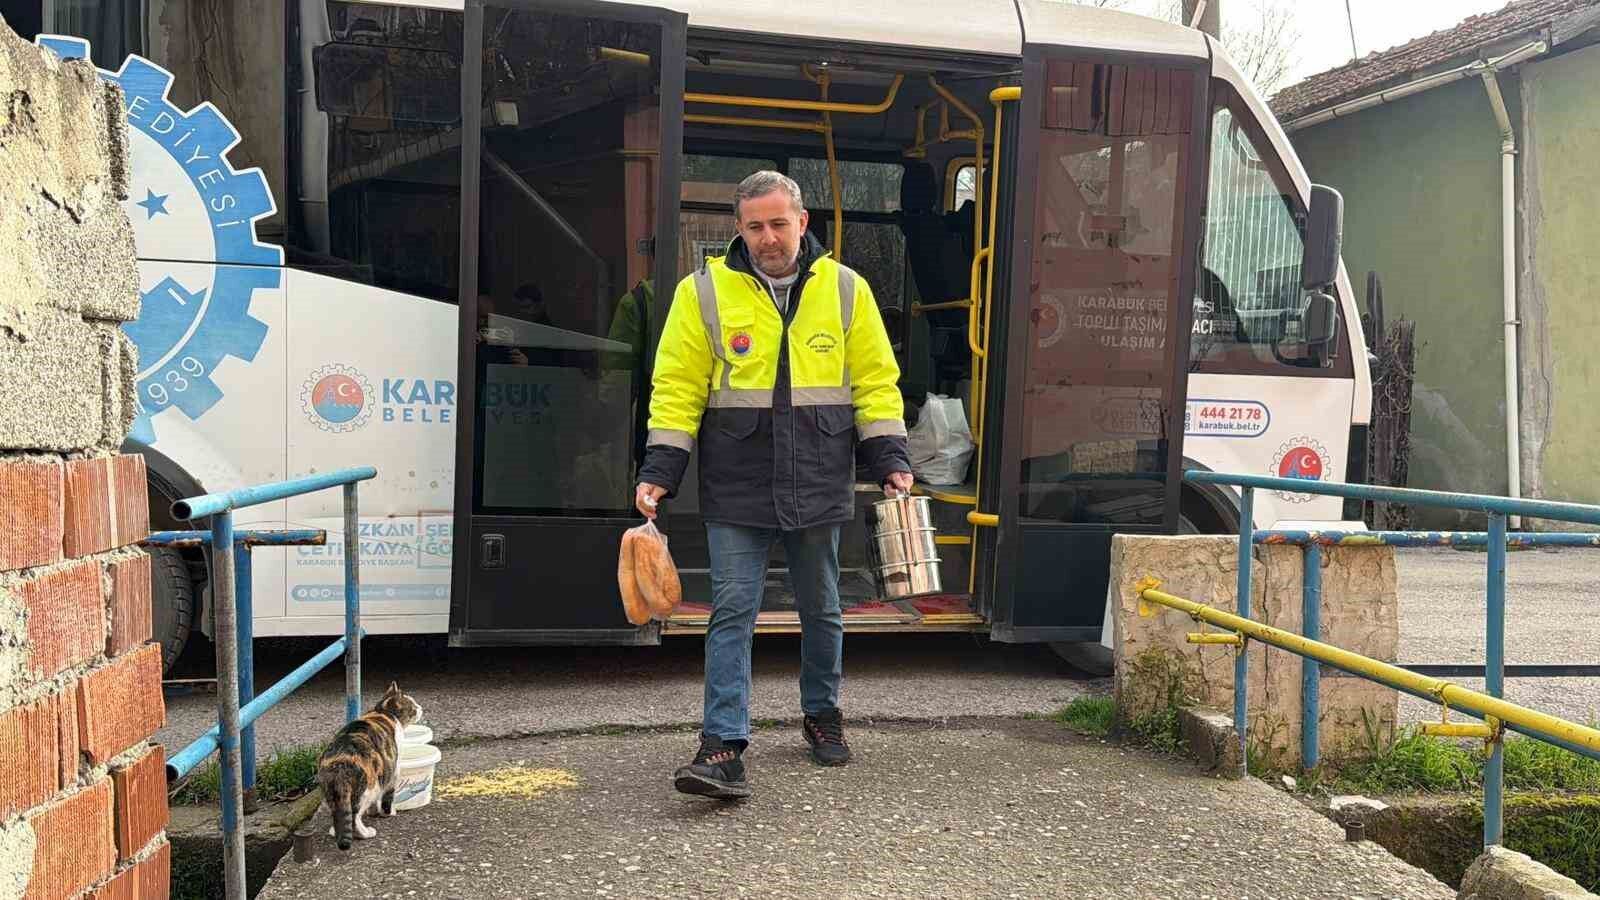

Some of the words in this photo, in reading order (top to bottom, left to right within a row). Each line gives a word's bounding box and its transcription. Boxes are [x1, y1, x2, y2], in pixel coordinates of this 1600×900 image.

[126, 95, 245, 229] EDİYESİ
[1191, 319, 1213, 335] ACI
[1200, 407, 1226, 419] 444
[1229, 408, 1243, 419] 21
[1246, 408, 1262, 420] 78
[1199, 421, 1261, 431] karabuk.bel.tr
[360, 523, 415, 537] ZKAN
